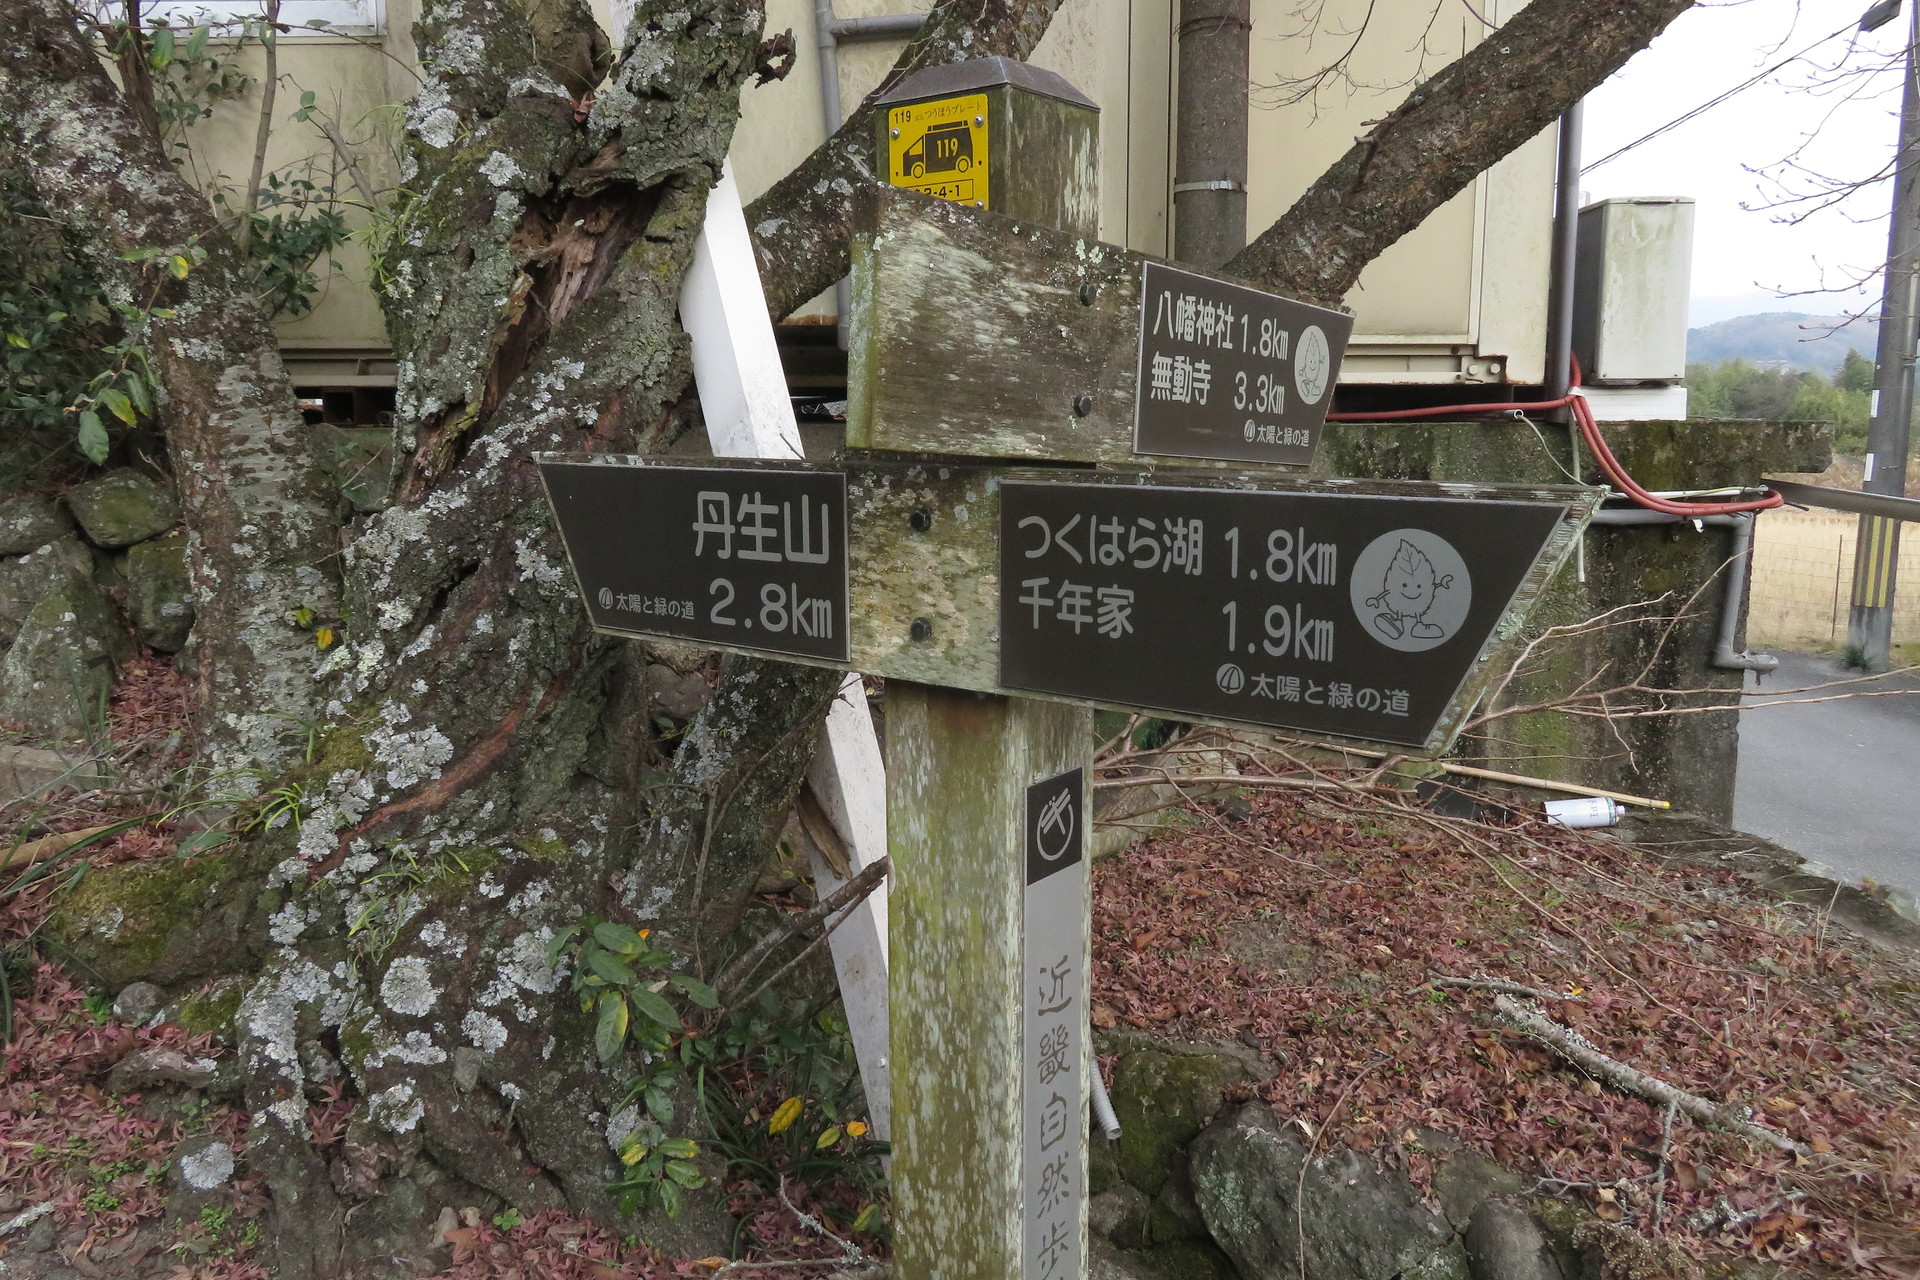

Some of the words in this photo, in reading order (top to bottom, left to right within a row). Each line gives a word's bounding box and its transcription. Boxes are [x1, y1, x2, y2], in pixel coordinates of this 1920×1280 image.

[894, 110, 911, 124] 119
[936, 137, 959, 158] 119
[1153, 290, 1234, 349] 八幡神社
[1240, 314, 1289, 361] 1.8km
[1151, 351, 1212, 406] 無動寺
[1233, 370, 1286, 415] 3.3km
[1256, 424, 1310, 448] 太陽と緑の道
[692, 490, 830, 565] 丹生山
[1018, 513, 1203, 576] つくはら湖
[1224, 526, 1338, 587] 1.8km
[615, 592, 695, 620] 太陽と緑の道
[709, 577, 833, 639] 2.8km
[1018, 577, 1135, 640] 千年家
[1222, 601, 1334, 663] 1.9km
[1250, 672, 1410, 718] 太陽と緑の道
[1037, 954, 1073, 1280] 近畿自然歩
